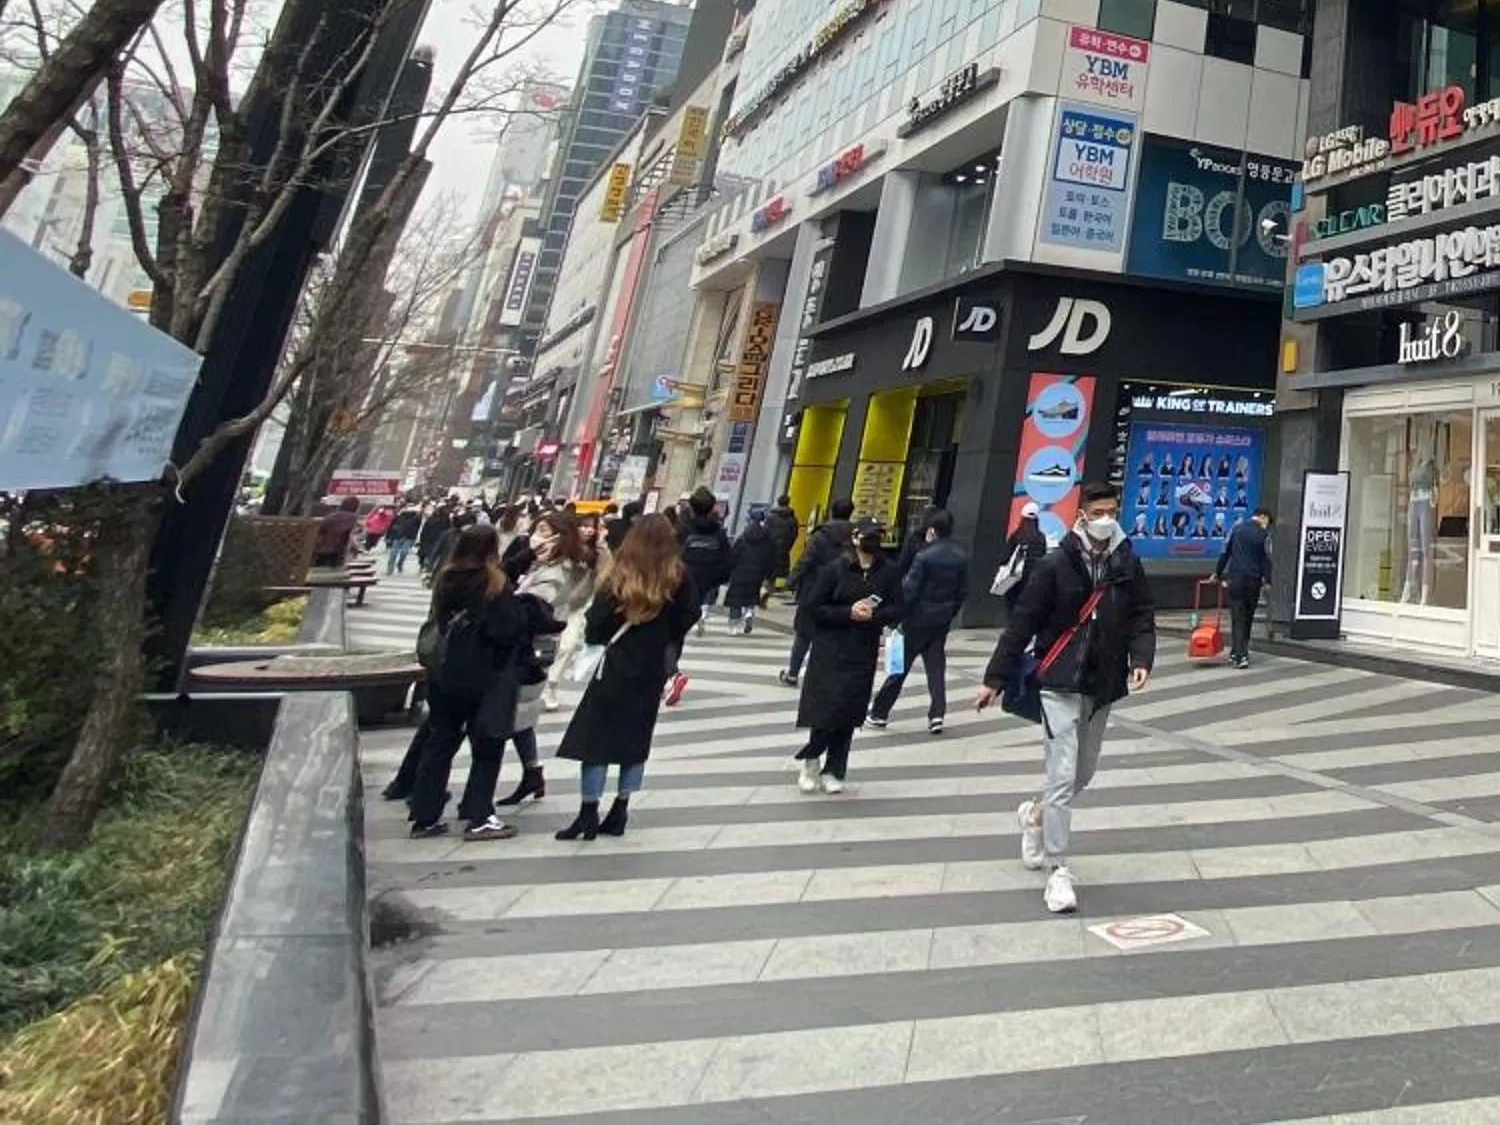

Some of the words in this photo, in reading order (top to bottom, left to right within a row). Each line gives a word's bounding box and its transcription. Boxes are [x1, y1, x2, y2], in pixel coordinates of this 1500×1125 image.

[1085, 55, 1129, 80] YBM
[1076, 73, 1134, 99] 유학센터
[1416, 84, 1466, 149] 듀오
[1075, 143, 1114, 165] YBM
[1302, 155, 1327, 179] LG
[1328, 137, 1389, 173] Mobile
[1069, 162, 1113, 185] 어학원
[958, 306, 997, 331] JD
[1027, 297, 1111, 355] JD
[902, 316, 934, 371] JD
[1156, 396, 1190, 411] KING
[1207, 400, 1274, 416] TRAINERS
[1306, 542, 1337, 554] EVENT
[1307, 530, 1339, 543] OPEN
